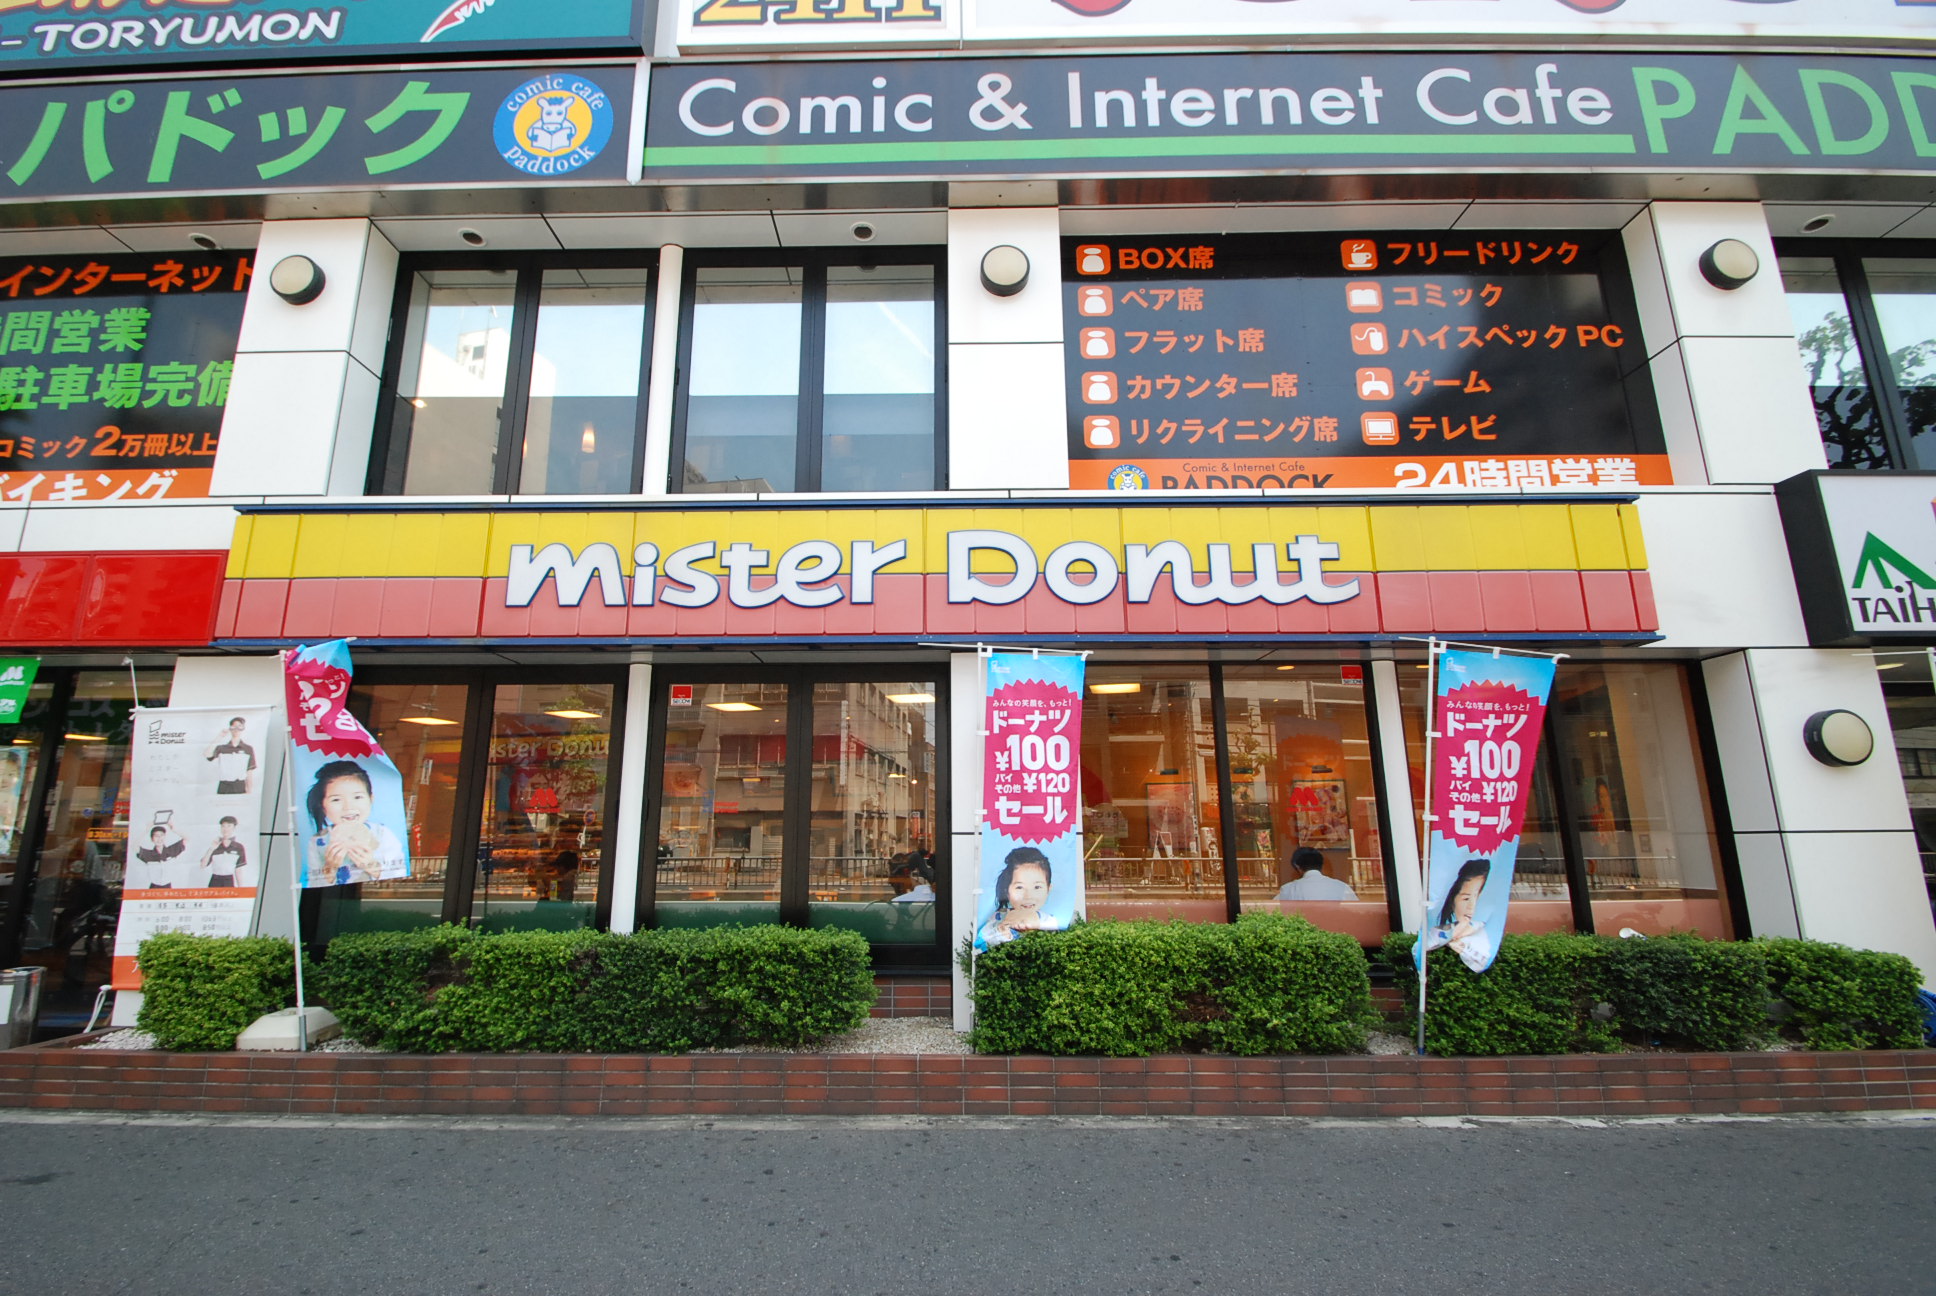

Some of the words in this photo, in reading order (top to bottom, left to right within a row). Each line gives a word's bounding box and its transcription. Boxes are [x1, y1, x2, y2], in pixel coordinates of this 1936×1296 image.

[34, 10, 341, 52] TORYUMON
[506, 74, 564, 112] comic
[571, 81, 605, 111] cafe
[678, 76, 934, 138] Comic
[968, 72, 1033, 131] &
[1067, 71, 1384, 129] Internet
[1416, 63, 1614, 126] Cafe
[6, 81, 471, 186] パドック
[503, 145, 596, 174] paddock
[1118, 245, 1215, 270] BOX席
[1386, 241, 1580, 265] フリードリンク
[1120, 286, 1205, 312] ペア席
[1392, 282, 1504, 308] コミック
[0, 307, 152, 355] 間営業
[1124, 327, 1266, 355] フラット席
[1126, 371, 1299, 400] カウンター席
[1403, 369, 1493, 396] ゲーム
[1129, 415, 1339, 444] リクライニング席
[1408, 413, 1498, 442] テレビ
[1182, 461, 1217, 473] Comic
[1233, 461, 1276, 472] Internet
[1279, 460, 1306, 471] Cafe
[505, 537, 907, 609] mister
[946, 528, 1361, 605] Donut
[992, 709, 1072, 735] ドーナツ
[1446, 711, 1529, 739] ドーナツ
[994, 734, 1071, 772] ¥100
[1448, 739, 1522, 779] ¥100
[994, 783, 1022, 794] その他
[1022, 772, 1071, 793] ¥120
[1449, 791, 1481, 803] その他
[1481, 780, 1519, 803] ¥120
[994, 795, 1069, 825] セール
[1448, 804, 1513, 836] セール
